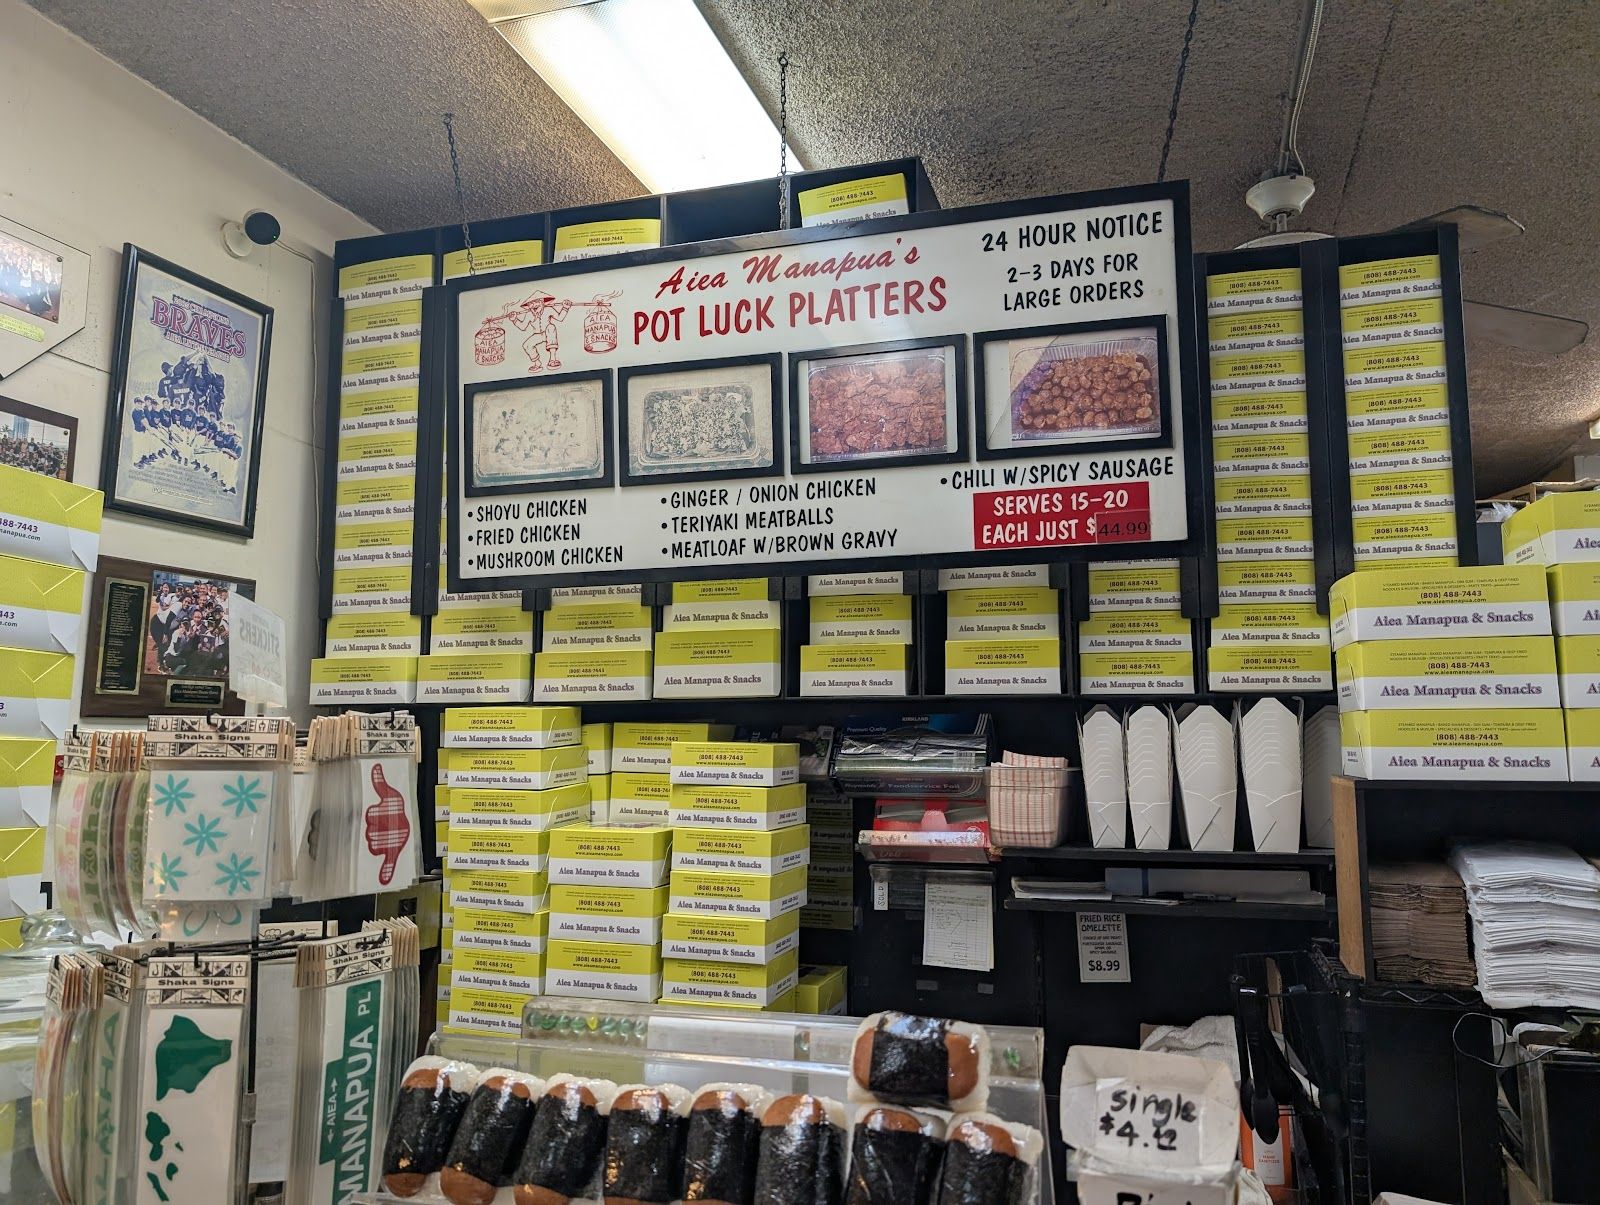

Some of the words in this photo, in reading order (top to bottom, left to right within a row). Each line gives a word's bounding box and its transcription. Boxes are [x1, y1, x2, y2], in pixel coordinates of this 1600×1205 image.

[982, 229, 1008, 252] 24
[1018, 222, 1076, 249] HOUR
[1086, 211, 1163, 241] NOTICE
[655, 265, 728, 300] Aiea
[742, 237, 920, 284] Manapua's
[1050, 256, 1095, 278] DAYS
[1103, 252, 1139, 274] FOR
[1363, 271, 1381, 280] (808)
[1383, 267, 1417, 276] 488-7443
[1003, 288, 1061, 312] LARGE
[1069, 279, 1145, 303] ORDERS
[1341, 293, 1360, 301] Aiea
[1362, 288, 1401, 299] Manapua
[1403, 285, 1411, 294] &
[1412, 282, 1442, 293] Snacks
[633, 306, 685, 345] POT
[699, 295, 774, 337] LUCK
[788, 276, 947, 328] PLATTERS
[589, 315, 611, 323] AIEA
[151, 296, 247, 359] BRAVES
[585, 325, 616, 335] MANAPUA
[480, 339, 498, 347] AIEA
[590, 333, 616, 343] SNACKS
[951, 469, 995, 490] CHILI
[1003, 462, 1080, 487] W/SPICY
[1088, 456, 1174, 481] SAUSAGE
[670, 489, 728, 509] GINGER
[749, 483, 799, 503] ONION
[806, 477, 876, 499] CHICKEN
[476, 502, 521, 523] SHOYU
[526, 498, 587, 520] CHICKEN
[993, 492, 1063, 517] SERVES
[671, 513, 739, 534] TERIYAKI
[745, 507, 834, 530] MEATBALLS
[476, 527, 514, 547] FRIED
[520, 522, 581, 544] CHICKEN
[982, 520, 1028, 545] EACH
[1034, 517, 1079, 541] JUST
[671, 538, 747, 559] MEATLOAF
[752, 532, 835, 554] W/BROWN
[841, 528, 898, 550] GRAVY
[476, 549, 556, 571] MUSHROOM
[561, 545, 623, 567] CHICKEN
[1420, 591, 1441, 600] (808)
[1443, 590, 1482, 598] 488-7443
[673, 614, 691, 622] Aiea
[692, 613, 730, 623] Manapua
[731, 612, 738, 620] &
[740, 611, 769, 620] Snacks
[1373, 615, 1403, 627] Aiea
[1406, 614, 1468, 628] Manapua
[1471, 612, 1484, 623] &
[1487, 610, 1534, 623] Snacks
[1427, 662, 1449, 670] (808)
[1451, 661, 1490, 669] 488-7443
[976, 677, 1011, 686] Manapua
[1020, 676, 1047, 684] Snacks
[1220, 676, 1239, 684] Aiea
[1241, 676, 1280, 685] Manapua
[1291, 675, 1322, 683] Snacks
[317, 688, 332, 697] Aiea
[333, 688, 365, 698] Manapua
[365, 687, 372, 695] &
[373, 686, 397, 695] Snacks
[1380, 685, 1410, 697] Aiea
[1413, 684, 1477, 698] Manapua
[1479, 684, 1492, 695] &
[1495, 682, 1543, 695] Snacks
[1436, 733, 1457, 741] (808)
[1388, 755, 1418, 767] Aiea
[1421, 756, 1485, 770] Manapua
[1488, 756, 1500, 768] &
[1503, 755, 1551, 768] Snacks
[678, 770, 694, 778] Aiea
[696, 770, 730, 780] Manapua
[731, 771, 737, 779] &
[739, 771, 764, 780] Snacks
[558, 867, 574, 875] Aiea
[575, 868, 607, 878] Manapua
[608, 868, 615, 876] &
[615, 868, 640, 878] Snacks
[1080, 914, 1102, 922] FRIED
[1103, 914, 1121, 922] RICE
[1081, 924, 1121, 932] OMELETTE
[333, 955, 359, 965] Shaka
[362, 950, 385, 959] Signs
[1088, 960, 1120, 971] $8.99
[357, 991, 372, 1016] PL
[326, 1094, 337, 1126] AIEA
